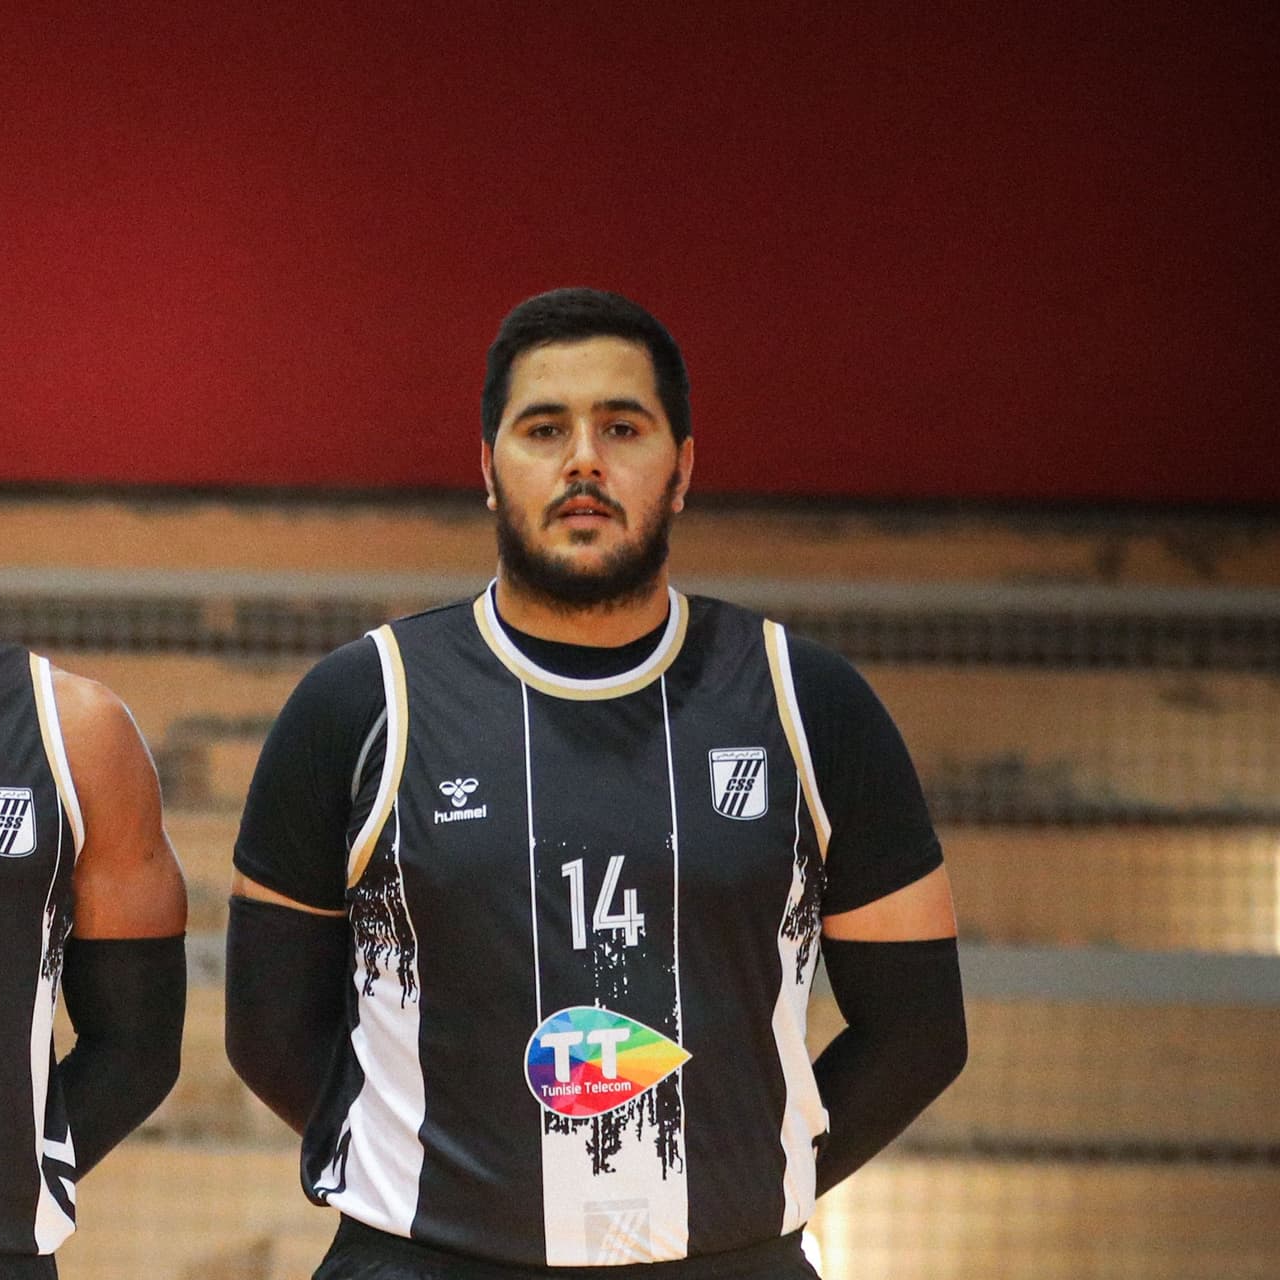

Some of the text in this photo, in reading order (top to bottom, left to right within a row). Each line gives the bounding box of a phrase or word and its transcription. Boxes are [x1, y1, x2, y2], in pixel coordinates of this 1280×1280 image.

[725, 778, 756, 792] CSS
[434, 804, 487, 825] hummel
[561, 855, 645, 951] 14
[540, 1028, 631, 1083] TT
[541, 1081, 632, 1097] Tunisie Telecom
